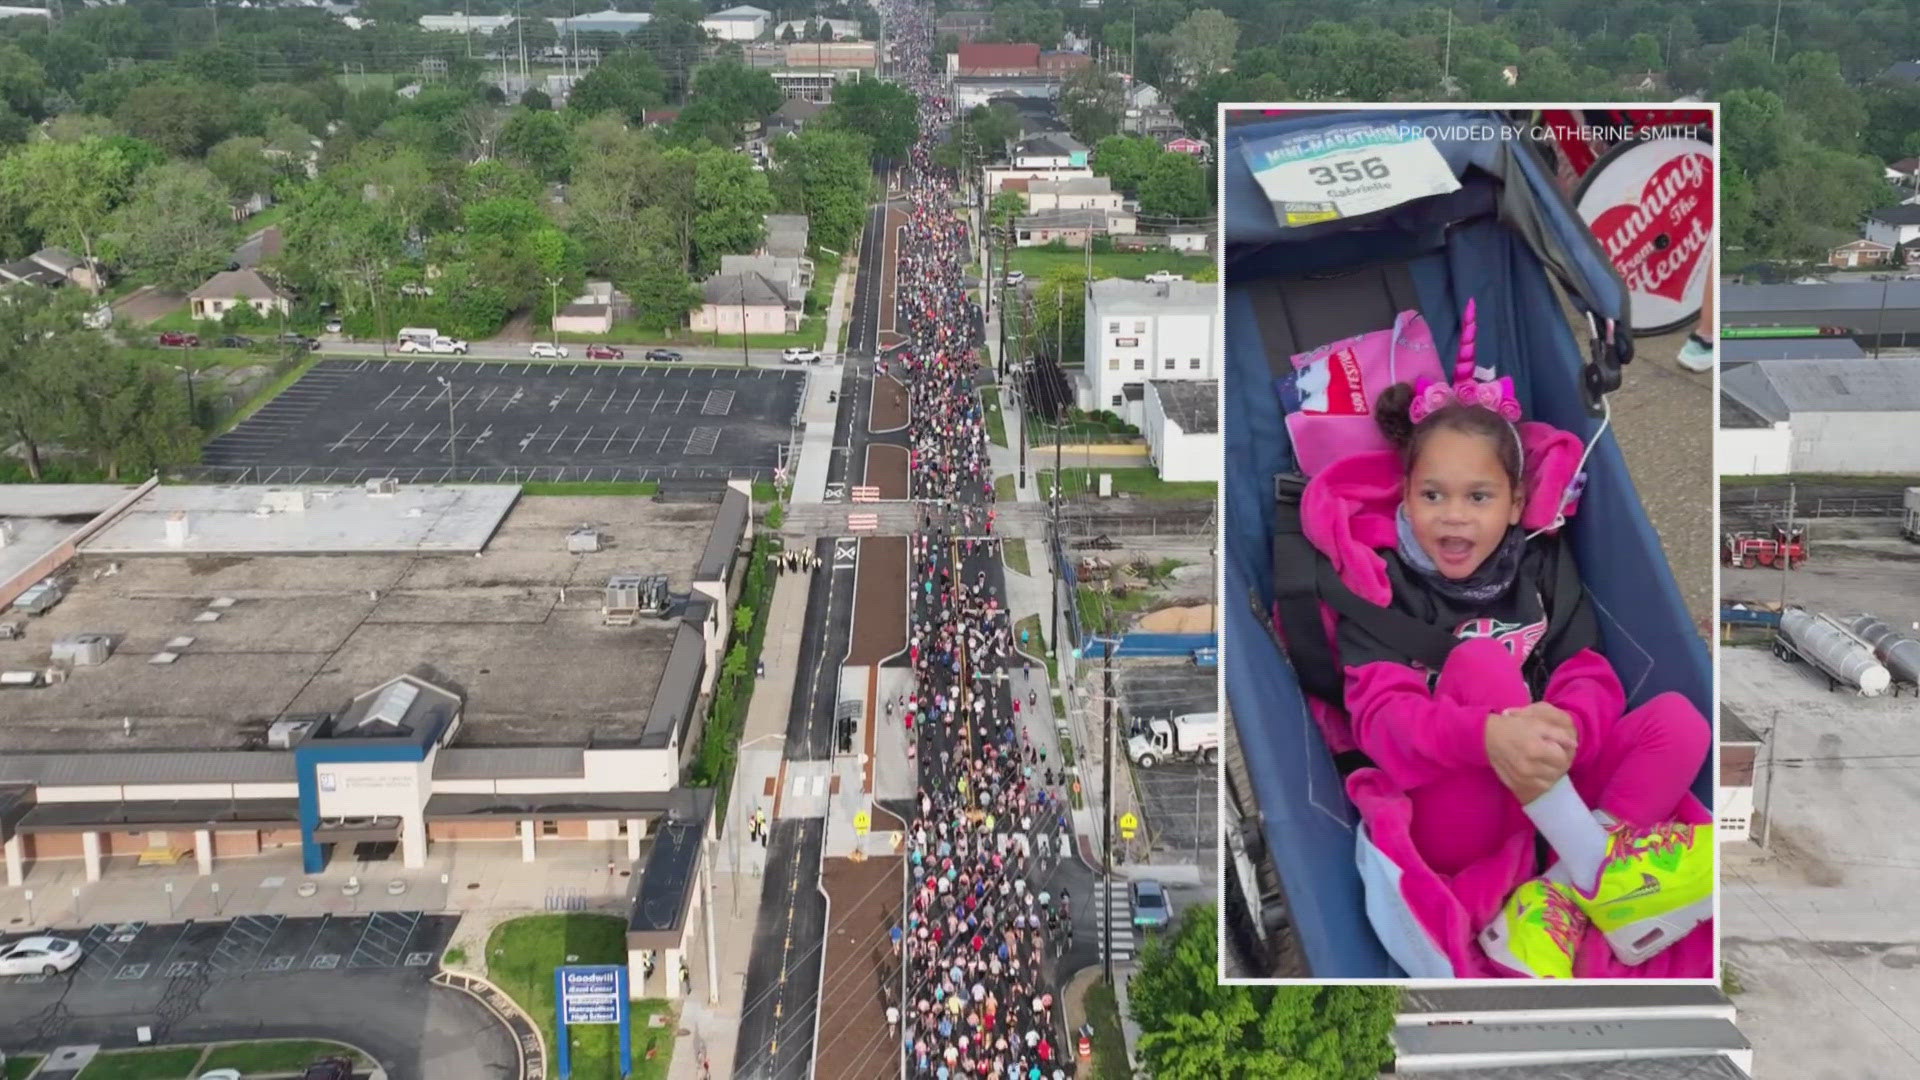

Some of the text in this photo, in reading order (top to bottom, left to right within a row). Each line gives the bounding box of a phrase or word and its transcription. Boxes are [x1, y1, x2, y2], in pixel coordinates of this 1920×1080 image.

[1265, 125, 1398, 165] MINI-MARATHON
[1308, 156, 1391, 186] 356
[1598, 153, 1704, 261] unning
[1616, 194, 1698, 277] From The
[1626, 217, 1709, 293] Heart
[567, 973, 614, 983] Goodwill
